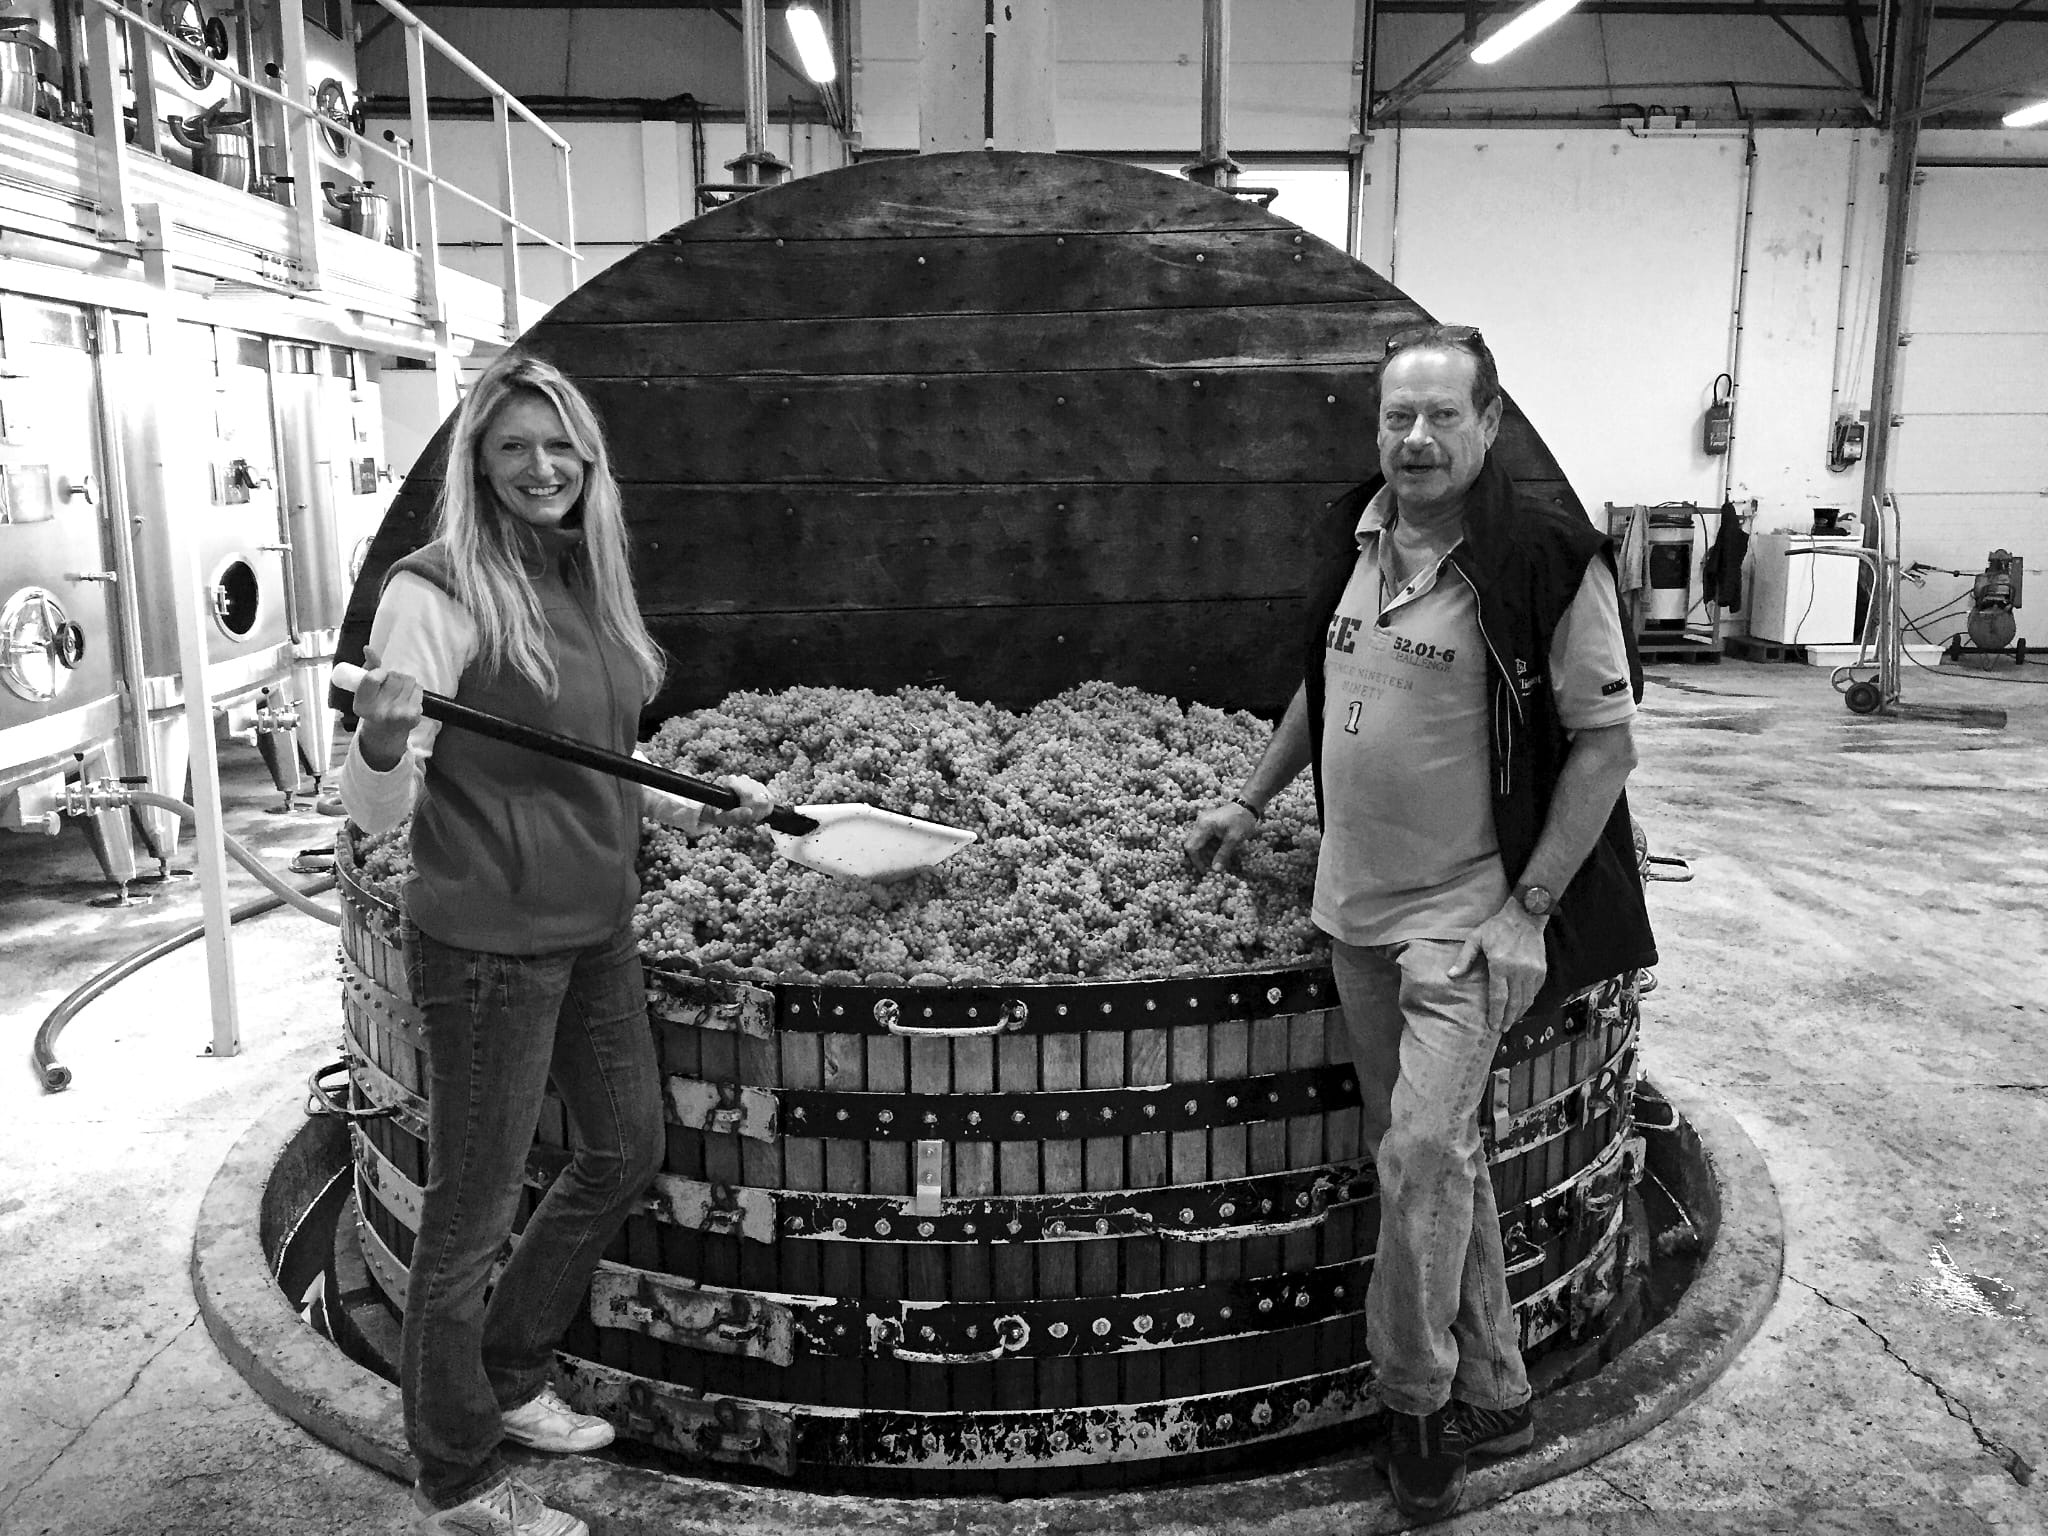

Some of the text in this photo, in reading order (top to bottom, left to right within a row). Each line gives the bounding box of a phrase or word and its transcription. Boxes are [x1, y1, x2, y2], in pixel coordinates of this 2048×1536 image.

[1393, 636, 1456, 663] 52.01-6
[1358, 667, 1414, 691] NINETEEN
[1344, 700, 1363, 735] 1
